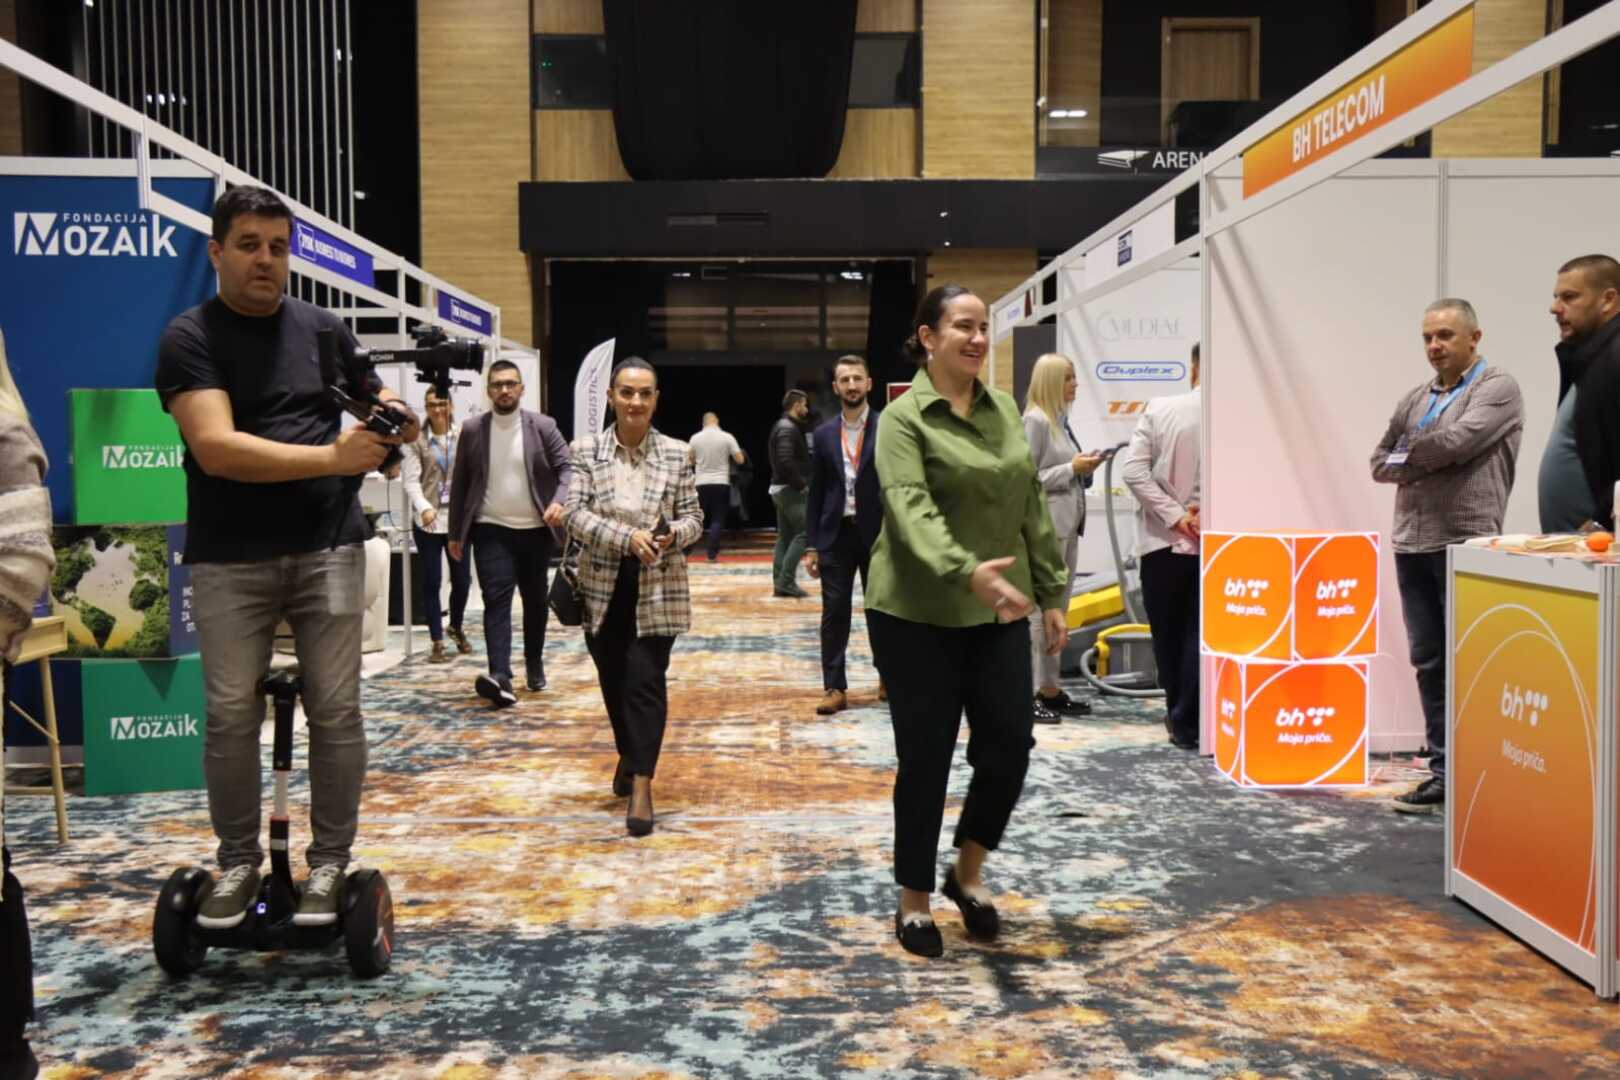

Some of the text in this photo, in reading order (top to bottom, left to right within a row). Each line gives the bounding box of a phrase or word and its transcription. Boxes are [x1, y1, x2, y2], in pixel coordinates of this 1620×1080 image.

[1292, 74, 1385, 162] BH TELECOM
[63, 213, 147, 223] FONDACIJA
[1103, 365, 1174, 375] Duplex
[1502, 682, 1524, 721] bh
[1275, 707, 1305, 727] bh
